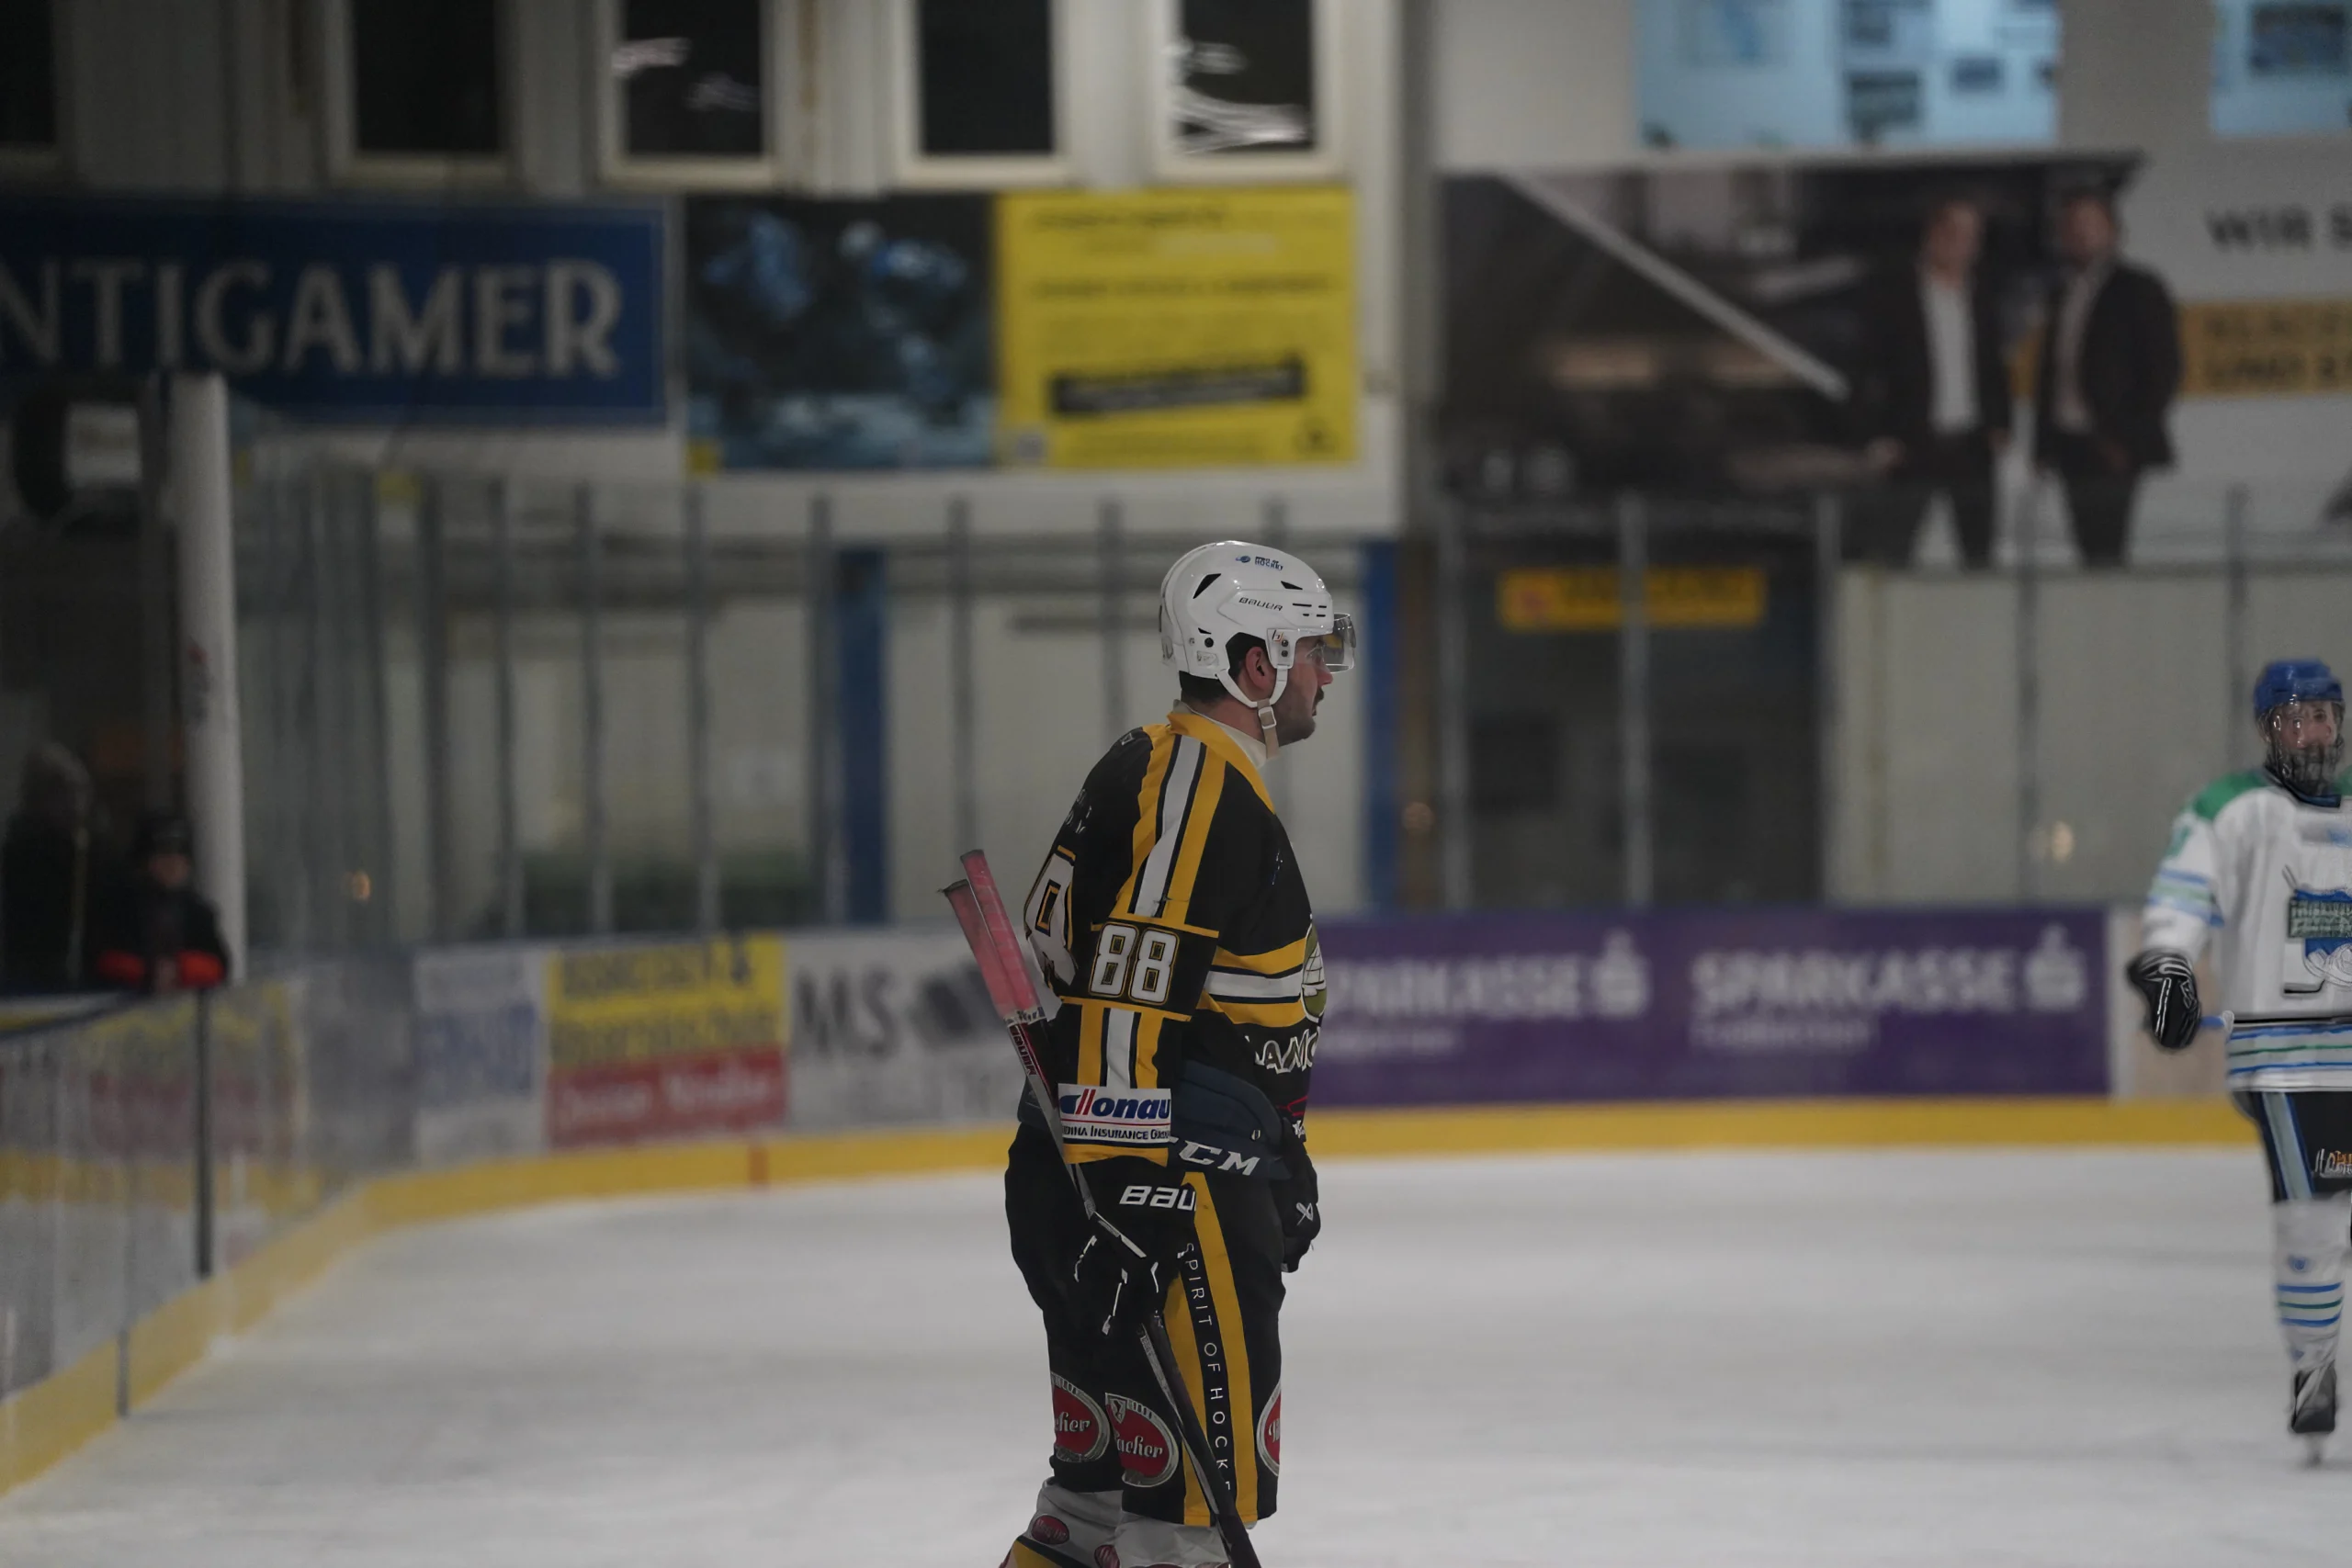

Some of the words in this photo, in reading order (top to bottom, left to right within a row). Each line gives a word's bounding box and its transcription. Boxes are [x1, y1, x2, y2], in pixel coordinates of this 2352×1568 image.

[2205, 205, 2311, 250] WIR
[0, 257, 623, 378] NTIGAMER
[1238, 597, 1283, 611] BAUER
[1088, 920, 1180, 1005] 88
[1690, 950, 2016, 1011] SPARKASSE
[797, 966, 901, 1060] MS
[1172, 1137, 1261, 1176] CM
[1119, 1185, 1197, 1212] BAU
[1204, 1342, 1221, 1374] OF
